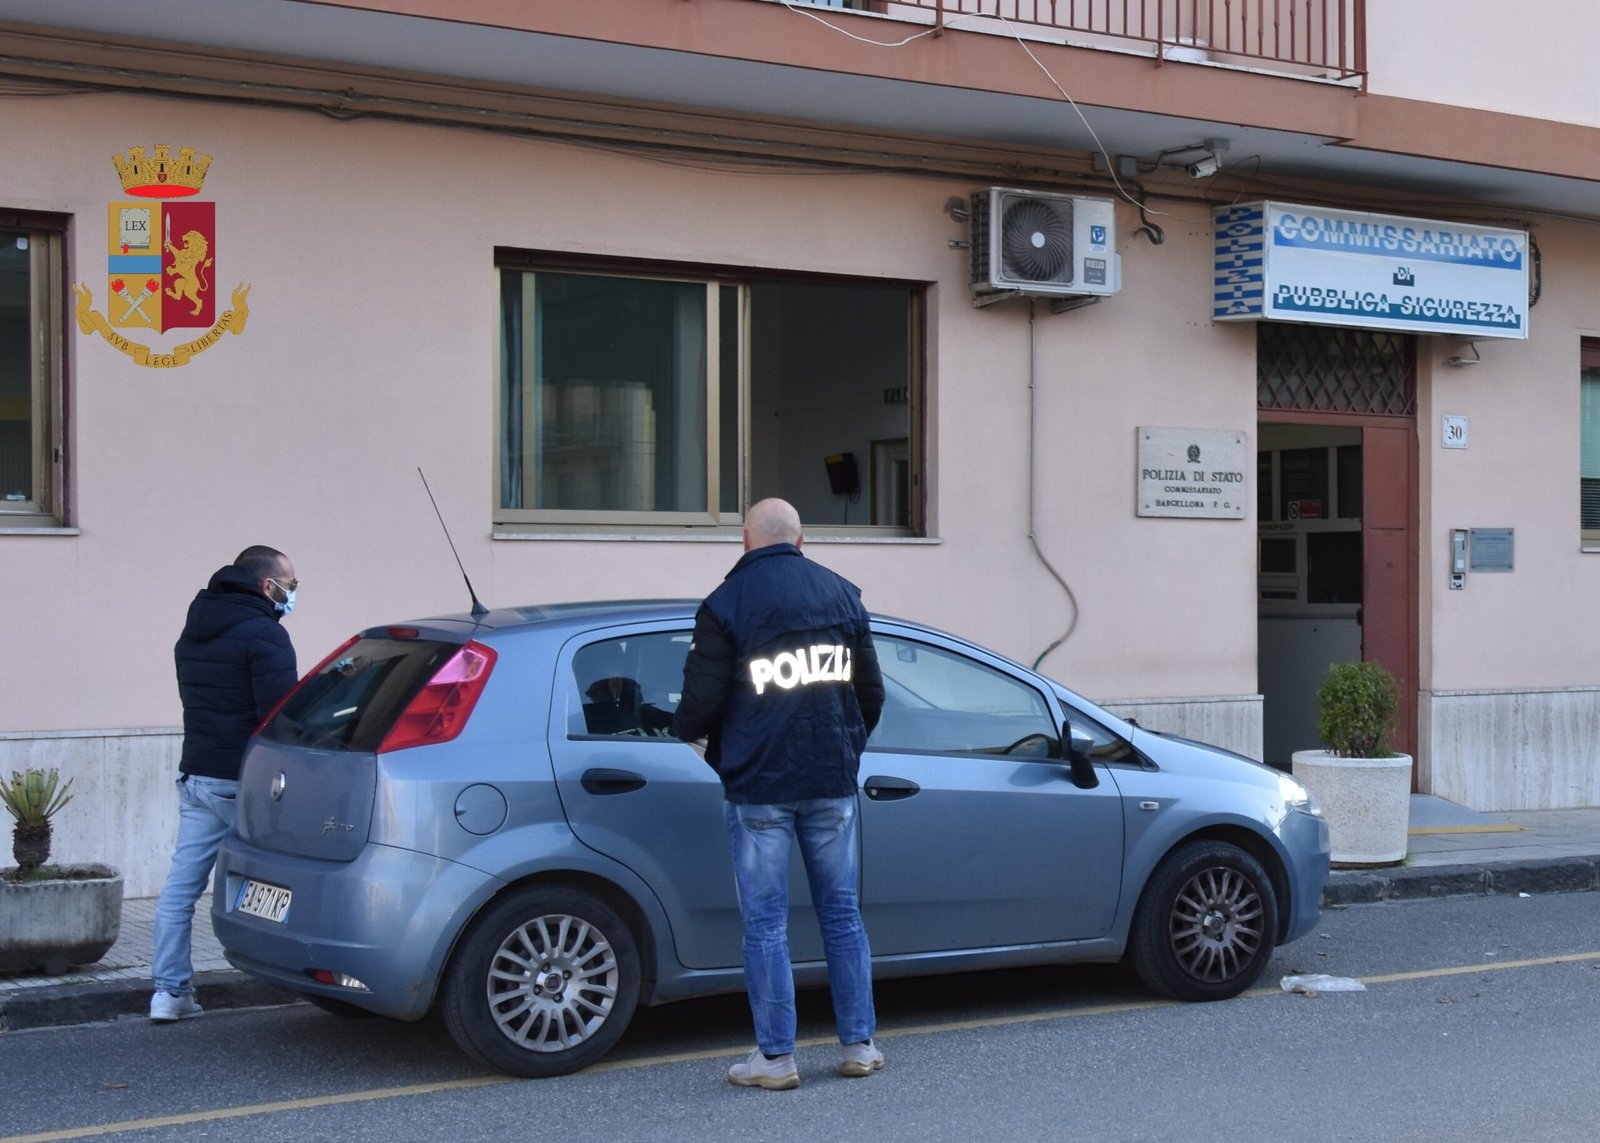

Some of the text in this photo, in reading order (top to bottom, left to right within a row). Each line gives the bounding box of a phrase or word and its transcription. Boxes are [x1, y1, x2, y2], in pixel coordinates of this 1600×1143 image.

[1279, 213, 1518, 263] COMMISSARIATO
[1278, 284, 1518, 324] PUBBLICA SICUREZZA
[1448, 425, 1463, 440] 30
[1142, 469, 1244, 483] POLIZIA DI STATO
[1164, 485, 1222, 495] COMMISSARIATO
[1155, 500, 1205, 509] BARCELLONA
